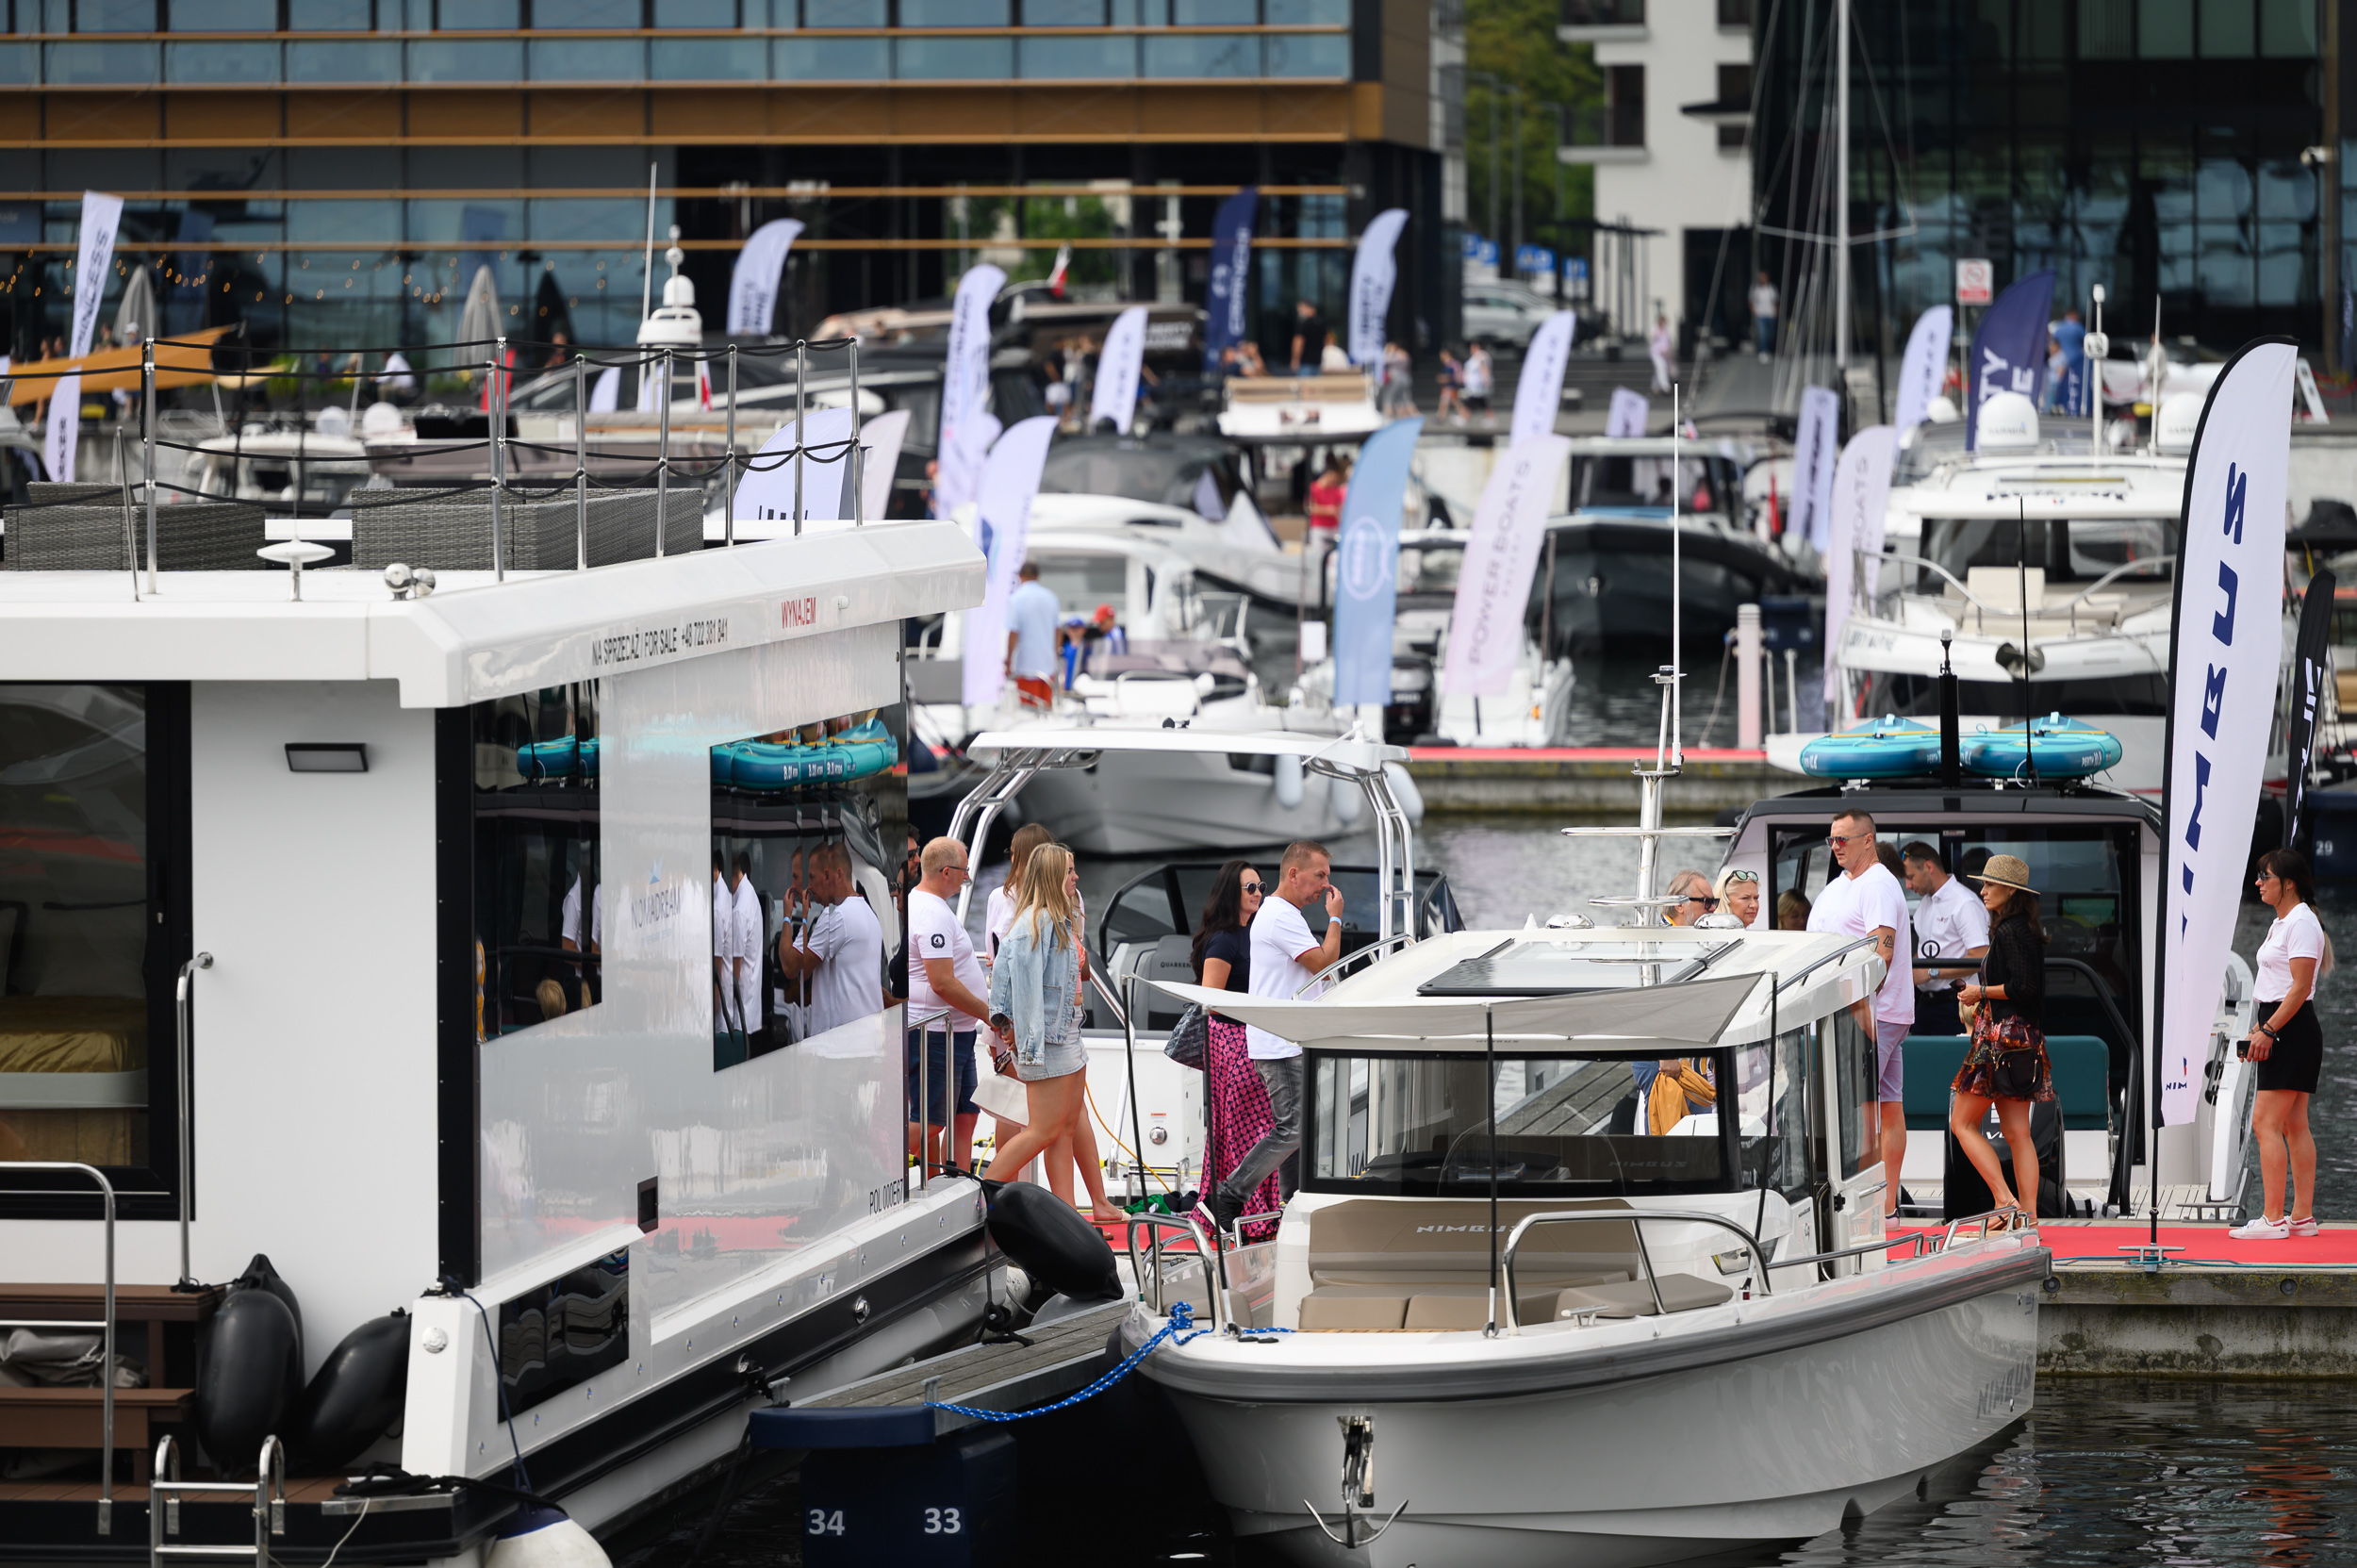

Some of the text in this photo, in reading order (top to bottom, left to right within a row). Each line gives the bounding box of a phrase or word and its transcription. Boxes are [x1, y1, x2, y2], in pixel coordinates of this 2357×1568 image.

[1468, 560, 1504, 665] POWER
[1492, 458, 1531, 553] BOATS
[781, 596, 817, 630] WYNAJEM
[591, 640, 602, 667] NA
[603, 627, 640, 665] SPRZEDAŻ
[645, 631, 659, 657] FOR
[660, 627, 678, 654] SALE
[2182, 461, 2248, 943] IMBUS
[2316, 840, 2333, 856] 29
[631, 885, 681, 932] NOMADREAM
[2166, 1081, 2187, 1091] NIM
[869, 1188, 882, 1217] POL
[1976, 1354, 2034, 1419] NIMBUS
[808, 1507, 962, 1537] 34 33
